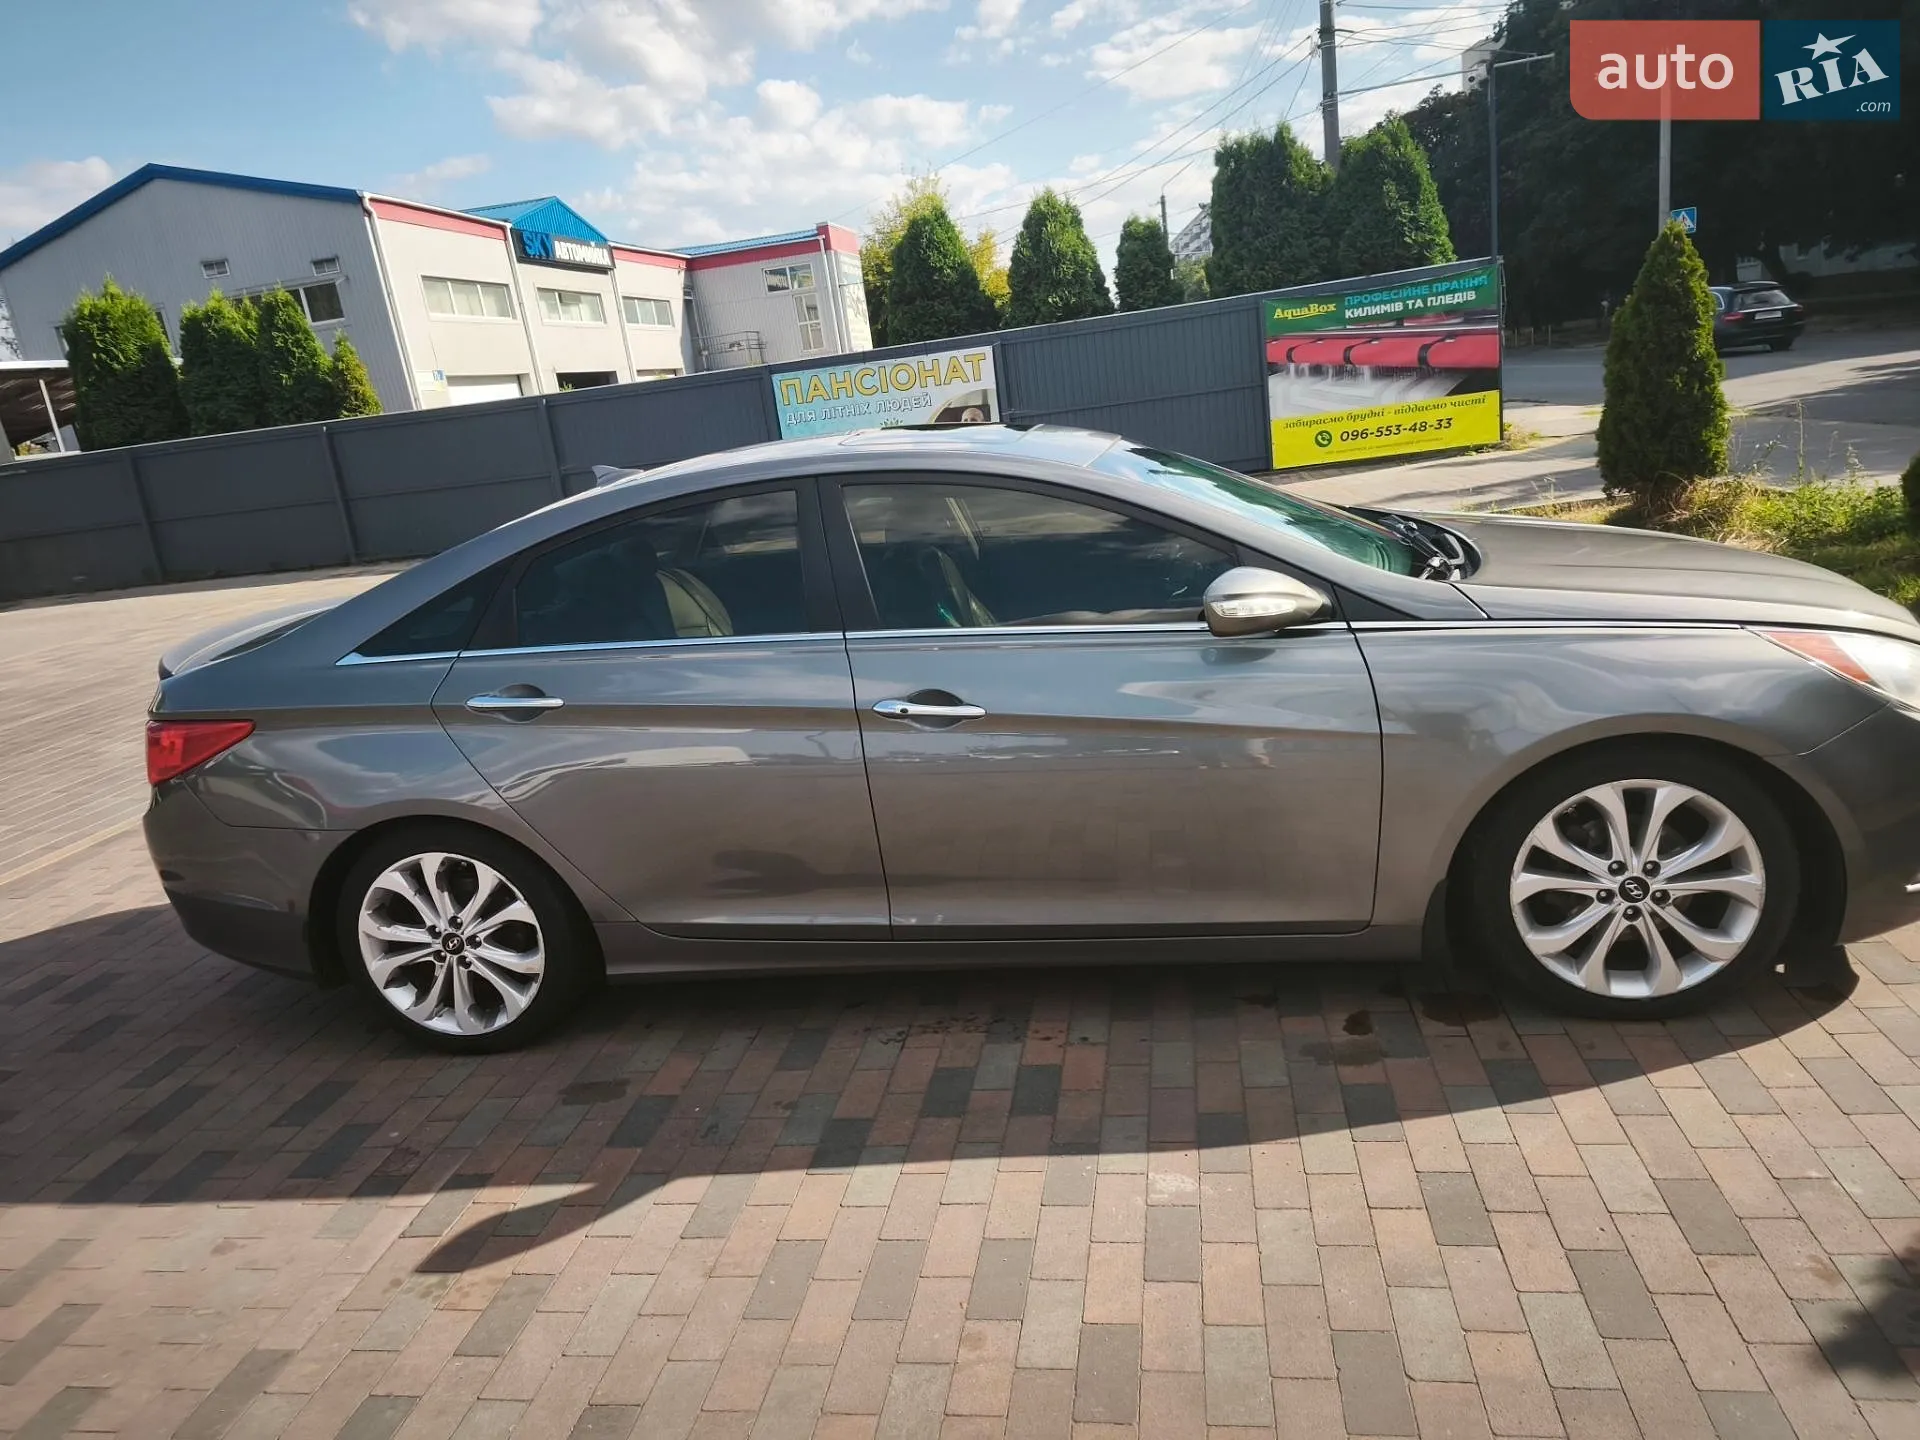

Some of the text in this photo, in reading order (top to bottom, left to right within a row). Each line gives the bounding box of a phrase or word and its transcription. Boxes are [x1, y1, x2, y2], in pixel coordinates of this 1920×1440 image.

[522, 231, 552, 260] SKY
[554, 240, 612, 267] АВТОМИЙКА
[1344, 275, 1488, 307] ПРОФЕСІЙНЕ ПРАННЯ
[1344, 290, 1477, 319] КИЛИМІВ ТА ПЛЕДІВ
[1273, 303, 1338, 320] AquaBox
[779, 352, 986, 407] ПАНСІОНАТ
[786, 392, 932, 425] ДЛЯ ЛІТНІХ ЛЮДЕЙ
[1340, 417, 1454, 442] 096-553-48-33
